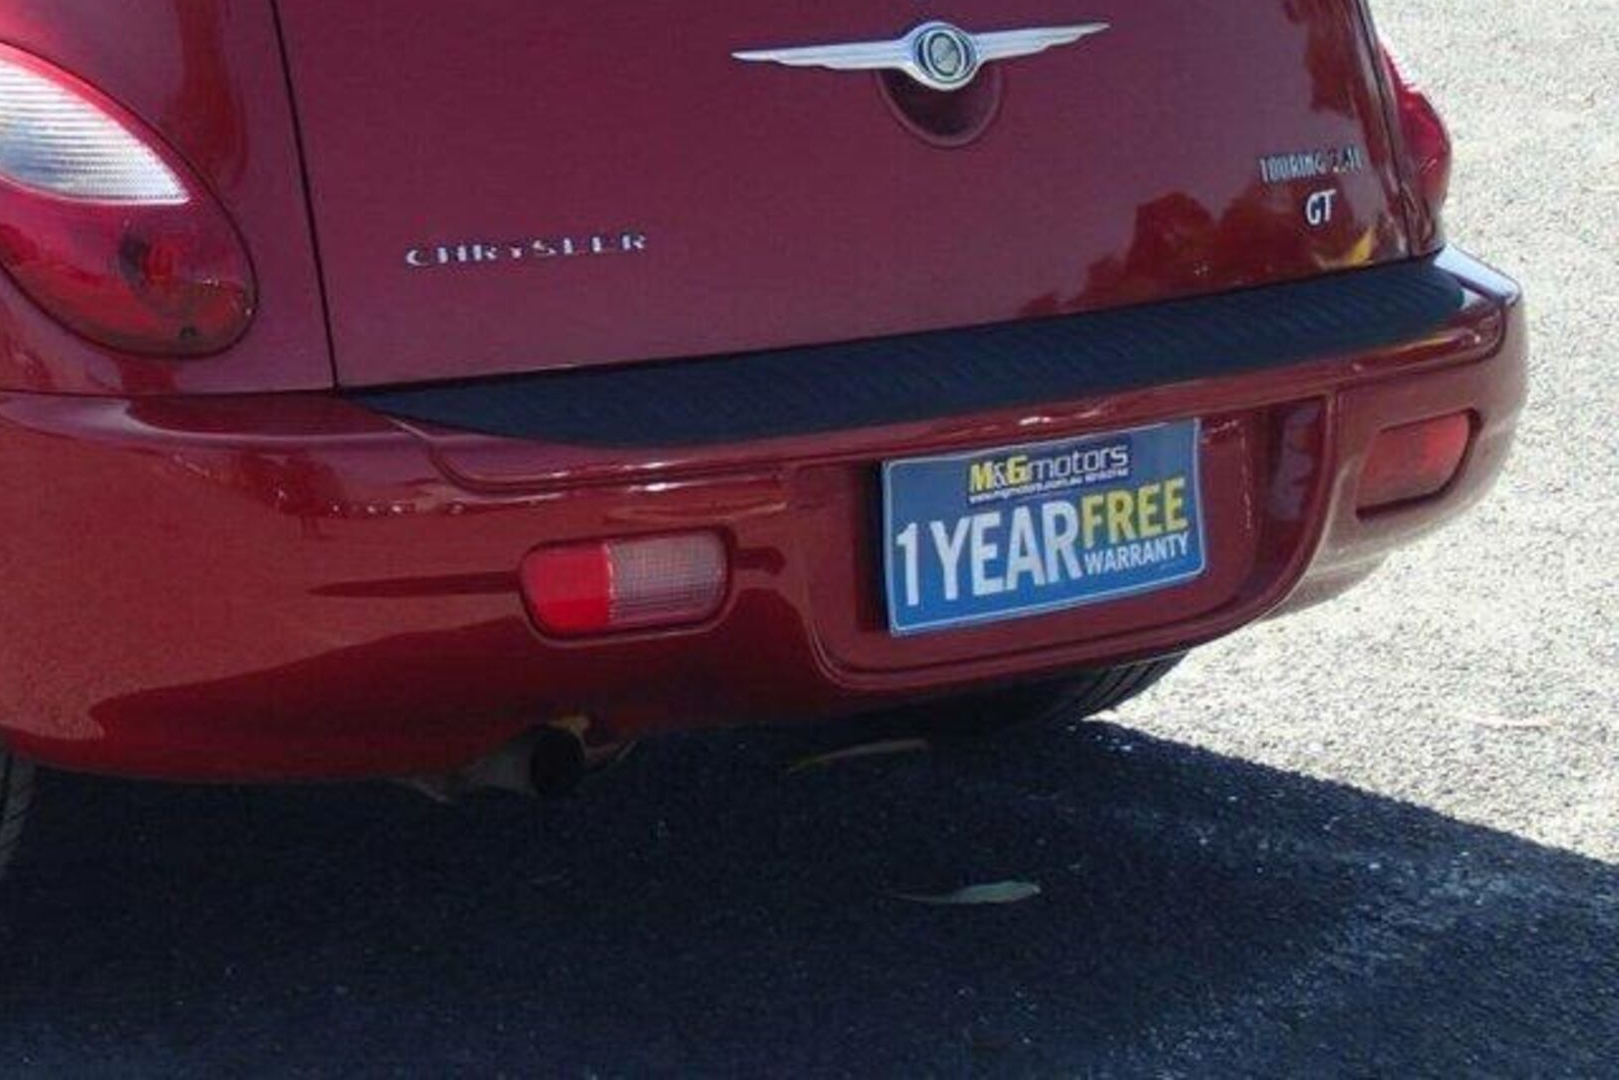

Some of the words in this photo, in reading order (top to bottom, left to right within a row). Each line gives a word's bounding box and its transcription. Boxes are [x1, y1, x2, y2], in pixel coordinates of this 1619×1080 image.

[1305, 187, 1337, 226] GT
[404, 233, 648, 267] CHRYSLER
[1084, 529, 1189, 577] WARRANTY
